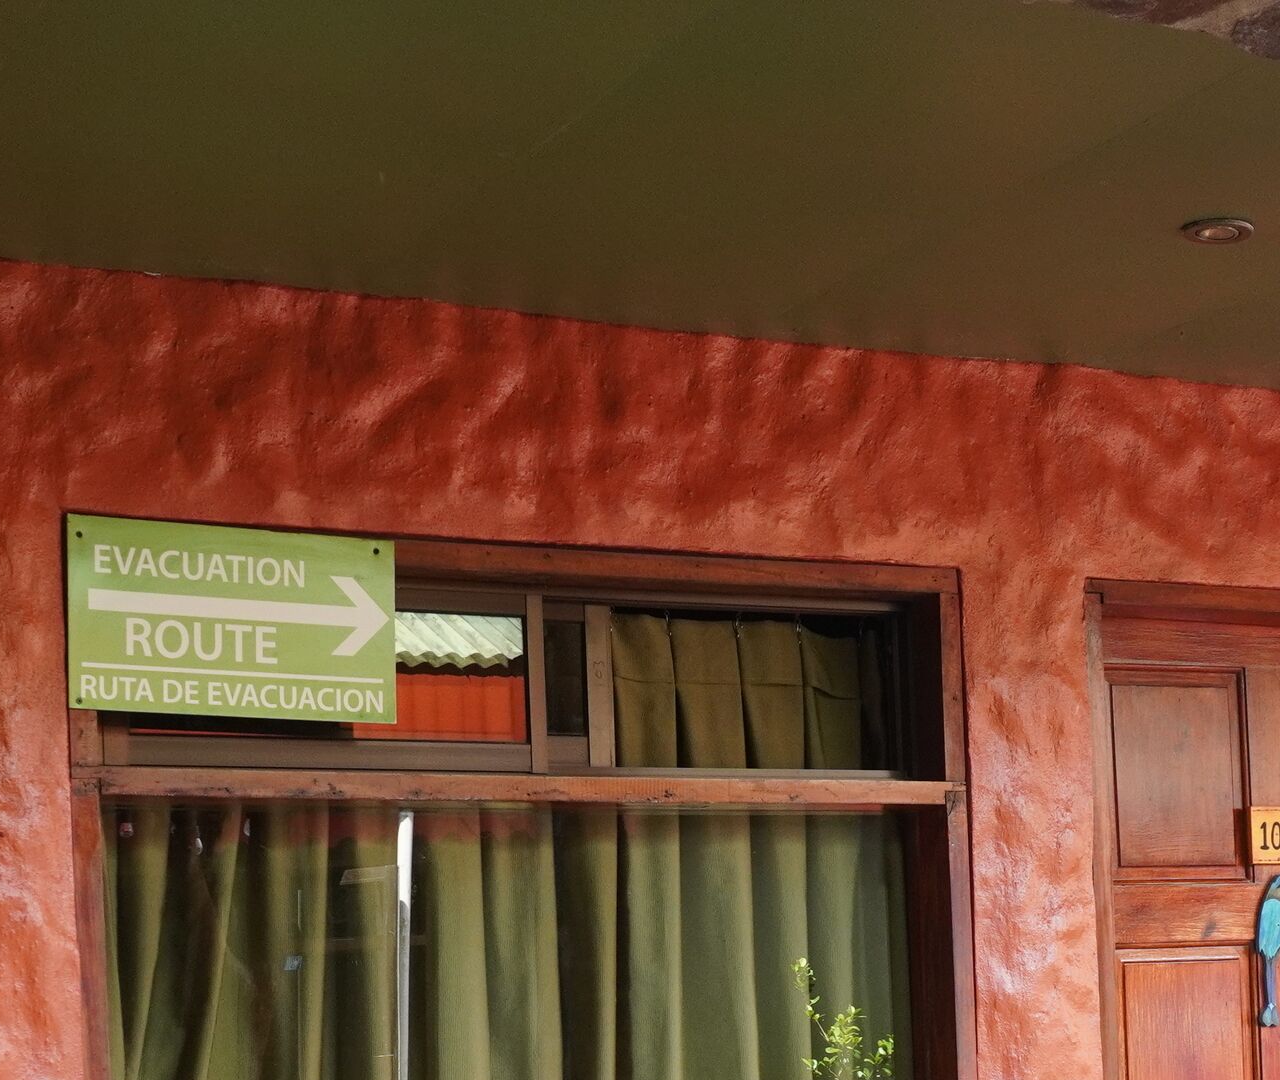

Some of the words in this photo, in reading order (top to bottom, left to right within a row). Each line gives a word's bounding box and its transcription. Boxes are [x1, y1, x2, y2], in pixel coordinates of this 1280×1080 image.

[93, 544, 305, 588] EVACUATION
[124, 617, 279, 665] ROUTE
[79, 674, 154, 702] RUTA
[162, 679, 200, 705] DE
[207, 682, 384, 714] EVACUACION
